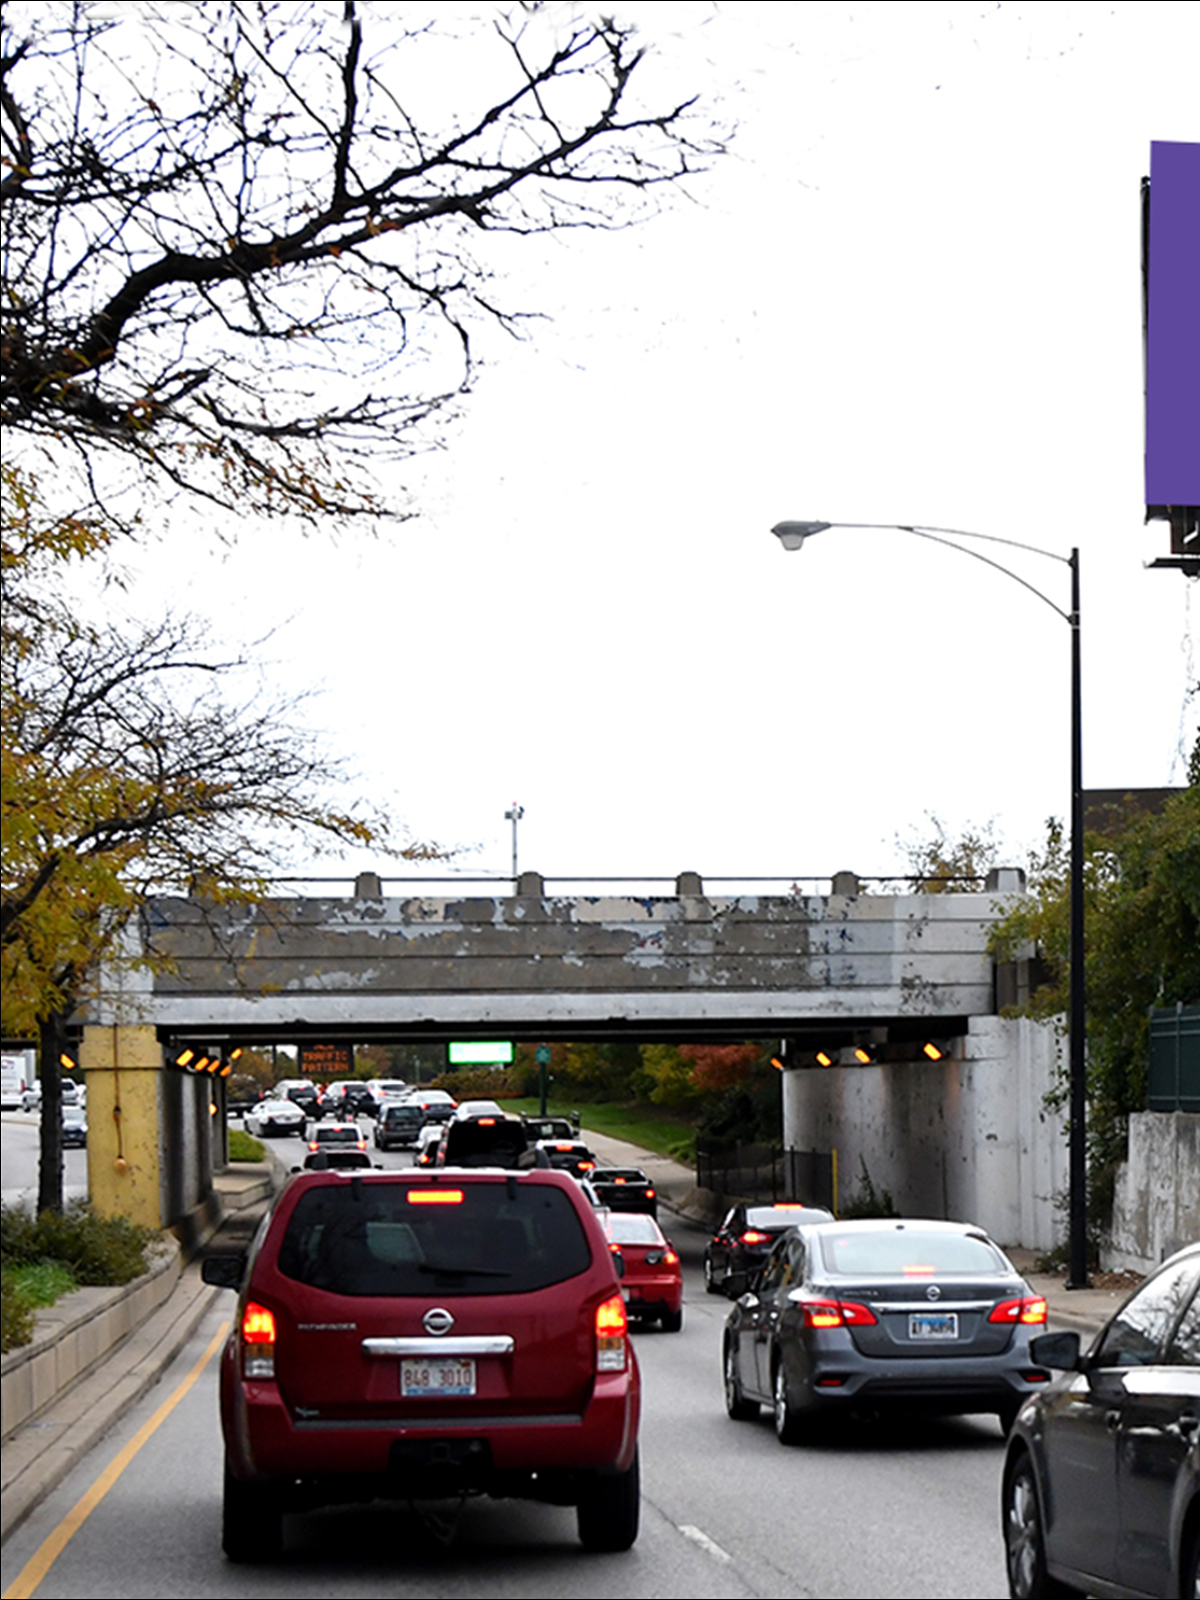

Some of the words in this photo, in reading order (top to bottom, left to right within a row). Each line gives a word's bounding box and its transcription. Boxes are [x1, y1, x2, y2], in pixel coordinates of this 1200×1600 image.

[303, 1051, 348, 1061] TRAFFIC
[302, 1062, 349, 1072] PATTERN
[440, 1369, 472, 1387] 3010
